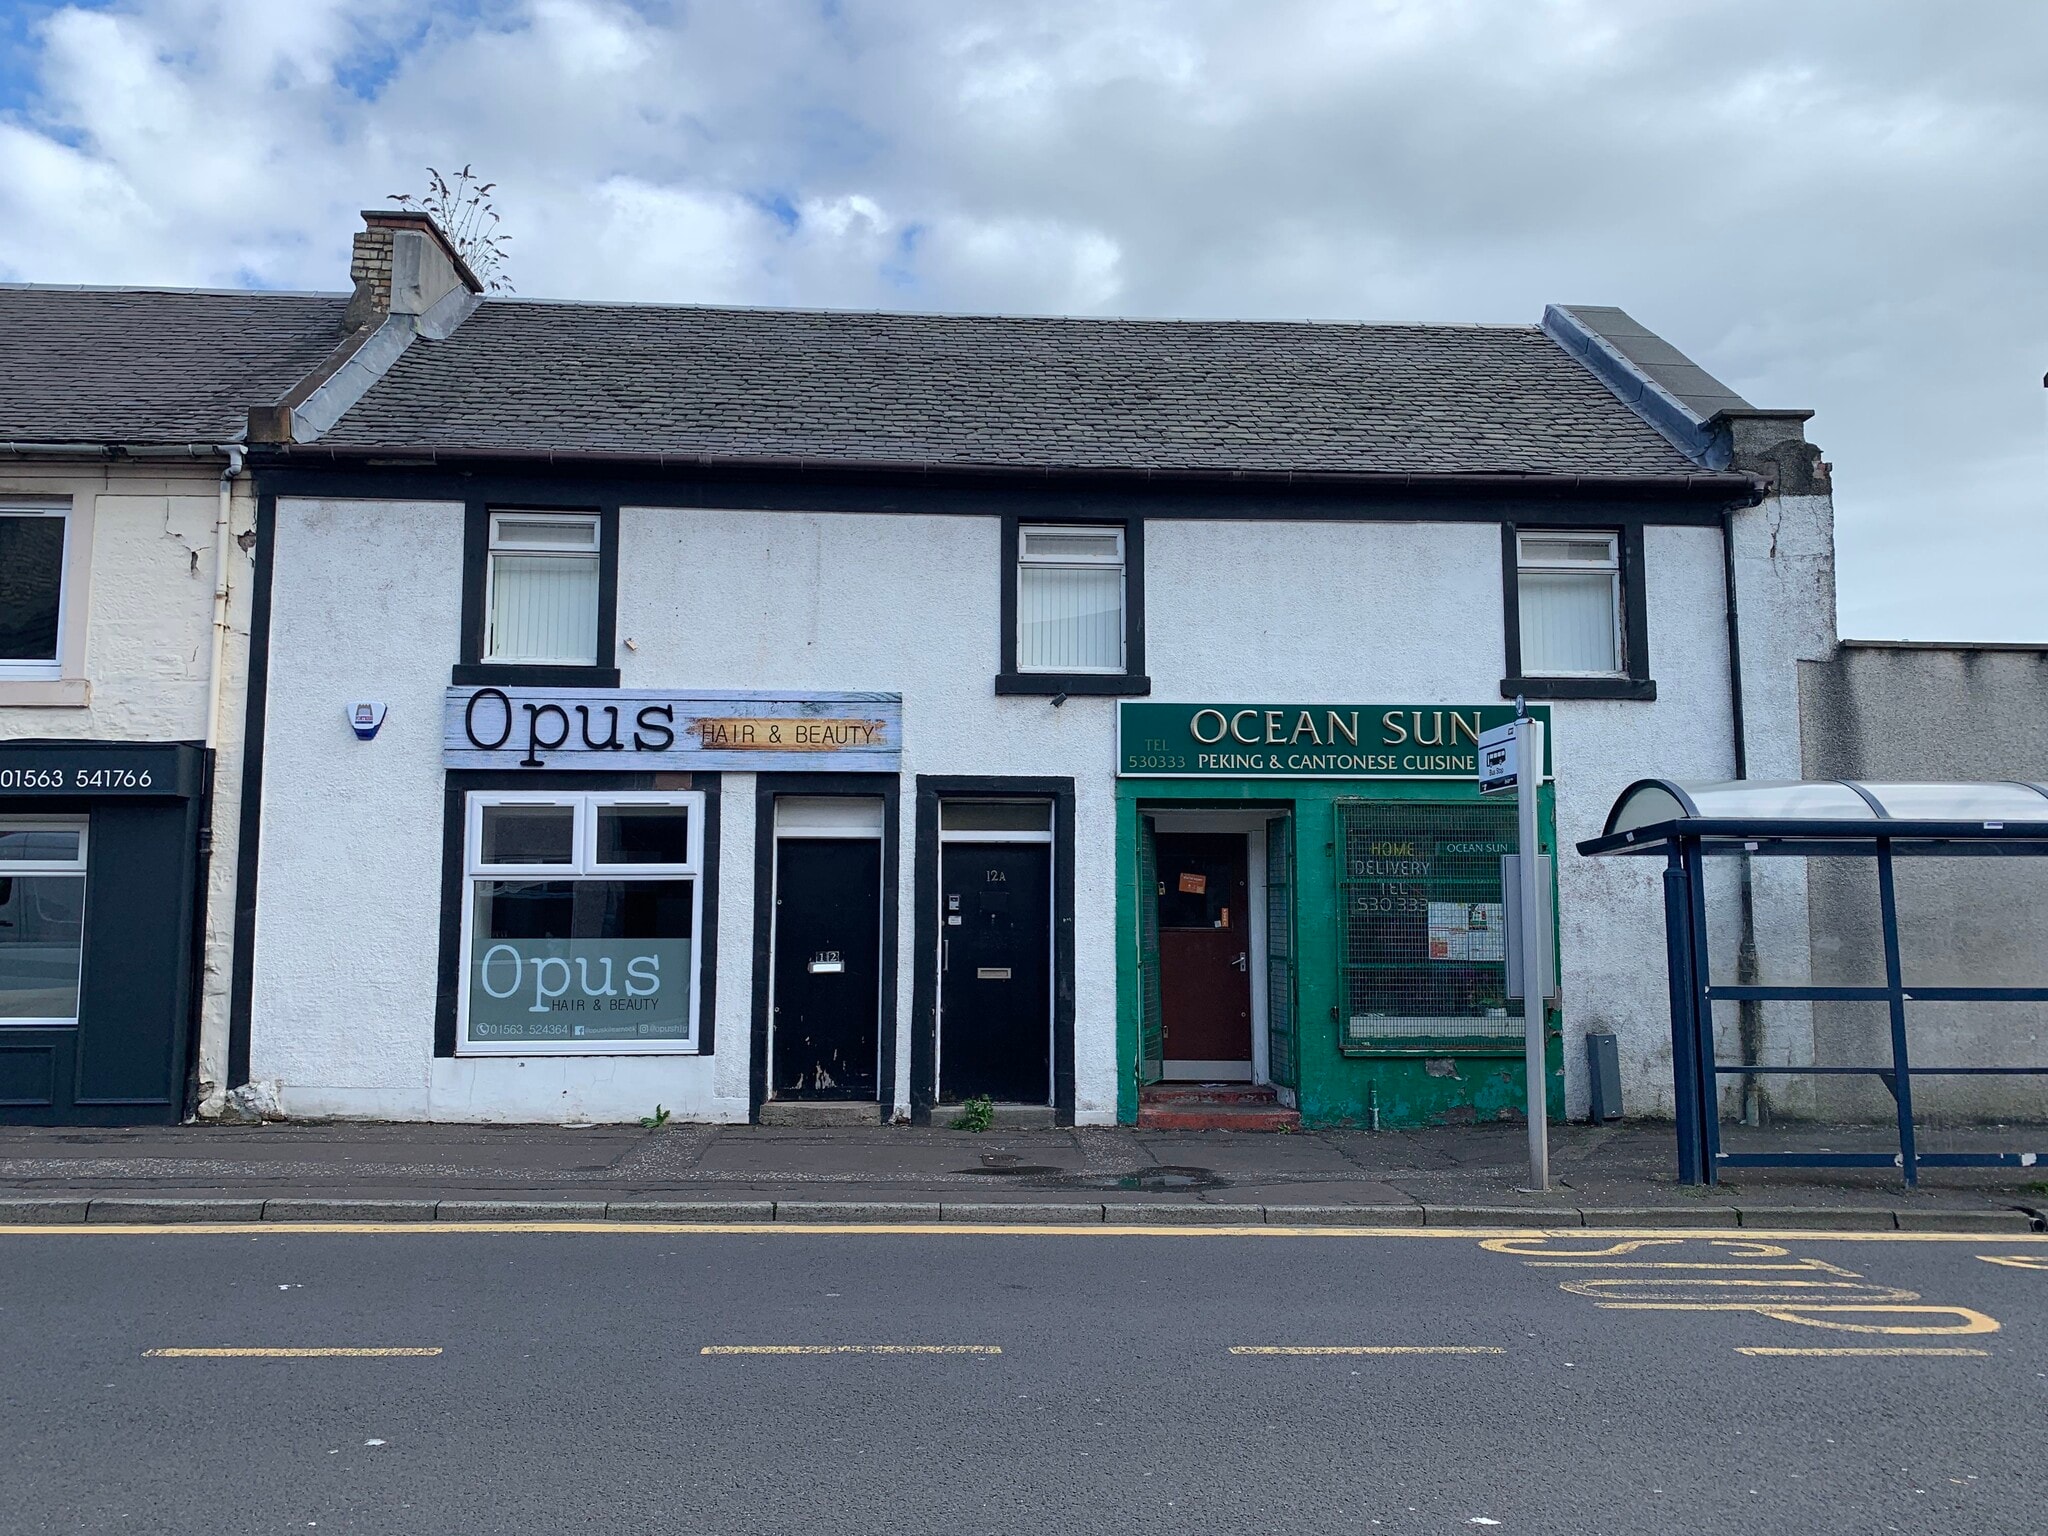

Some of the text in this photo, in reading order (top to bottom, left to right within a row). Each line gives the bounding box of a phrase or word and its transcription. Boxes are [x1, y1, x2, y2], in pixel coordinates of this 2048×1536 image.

[465, 687, 876, 767] Opus HAIR & BEAUTY
[1190, 709, 1482, 747] OCEAN SUN
[1145, 739, 1170, 751] TEL
[1129, 755, 1186, 768] 530333
[1198, 753, 1476, 770] PEKING & CANTONESE CUISINE
[1, 769, 152, 788] 01563 541766
[1371, 842, 1415, 857] HOME
[1447, 843, 1508, 853] OCEAN SUN
[1355, 860, 1430, 875] DELIVERY
[986, 870, 1006, 882] 12A
[1357, 897, 1429, 912] 530 333
[481, 944, 661, 1012] Opus
[552, 999, 659, 1011] HAIR & BEAUTY
[490, 1024, 523, 1035] 01563
[528, 1024, 568, 1035] 524364
